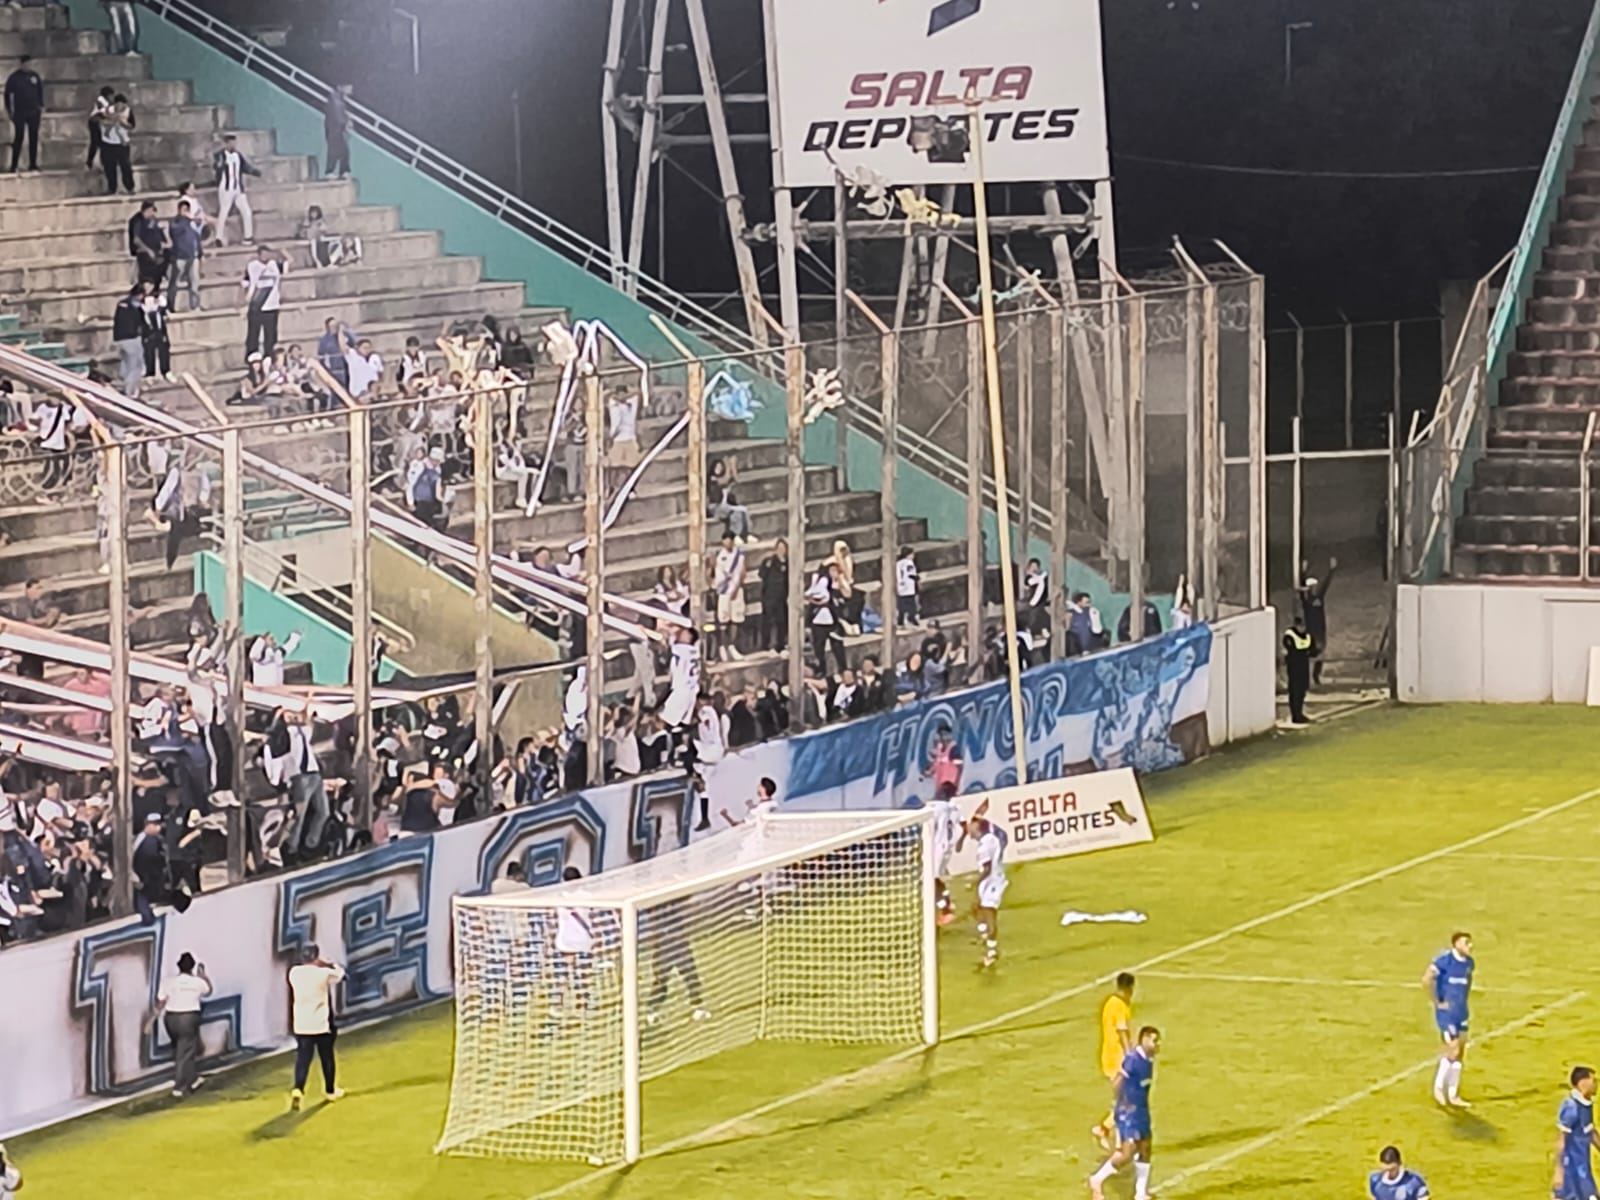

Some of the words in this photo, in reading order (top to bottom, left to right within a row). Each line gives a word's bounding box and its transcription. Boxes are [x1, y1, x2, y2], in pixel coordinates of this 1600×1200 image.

[845, 66, 1033, 109] SALTA
[803, 108, 1080, 152] DEPTES
[872, 672, 1067, 798] HONOR
[1007, 791, 1078, 823] SALTA
[1014, 809, 1116, 843] DEPORTES
